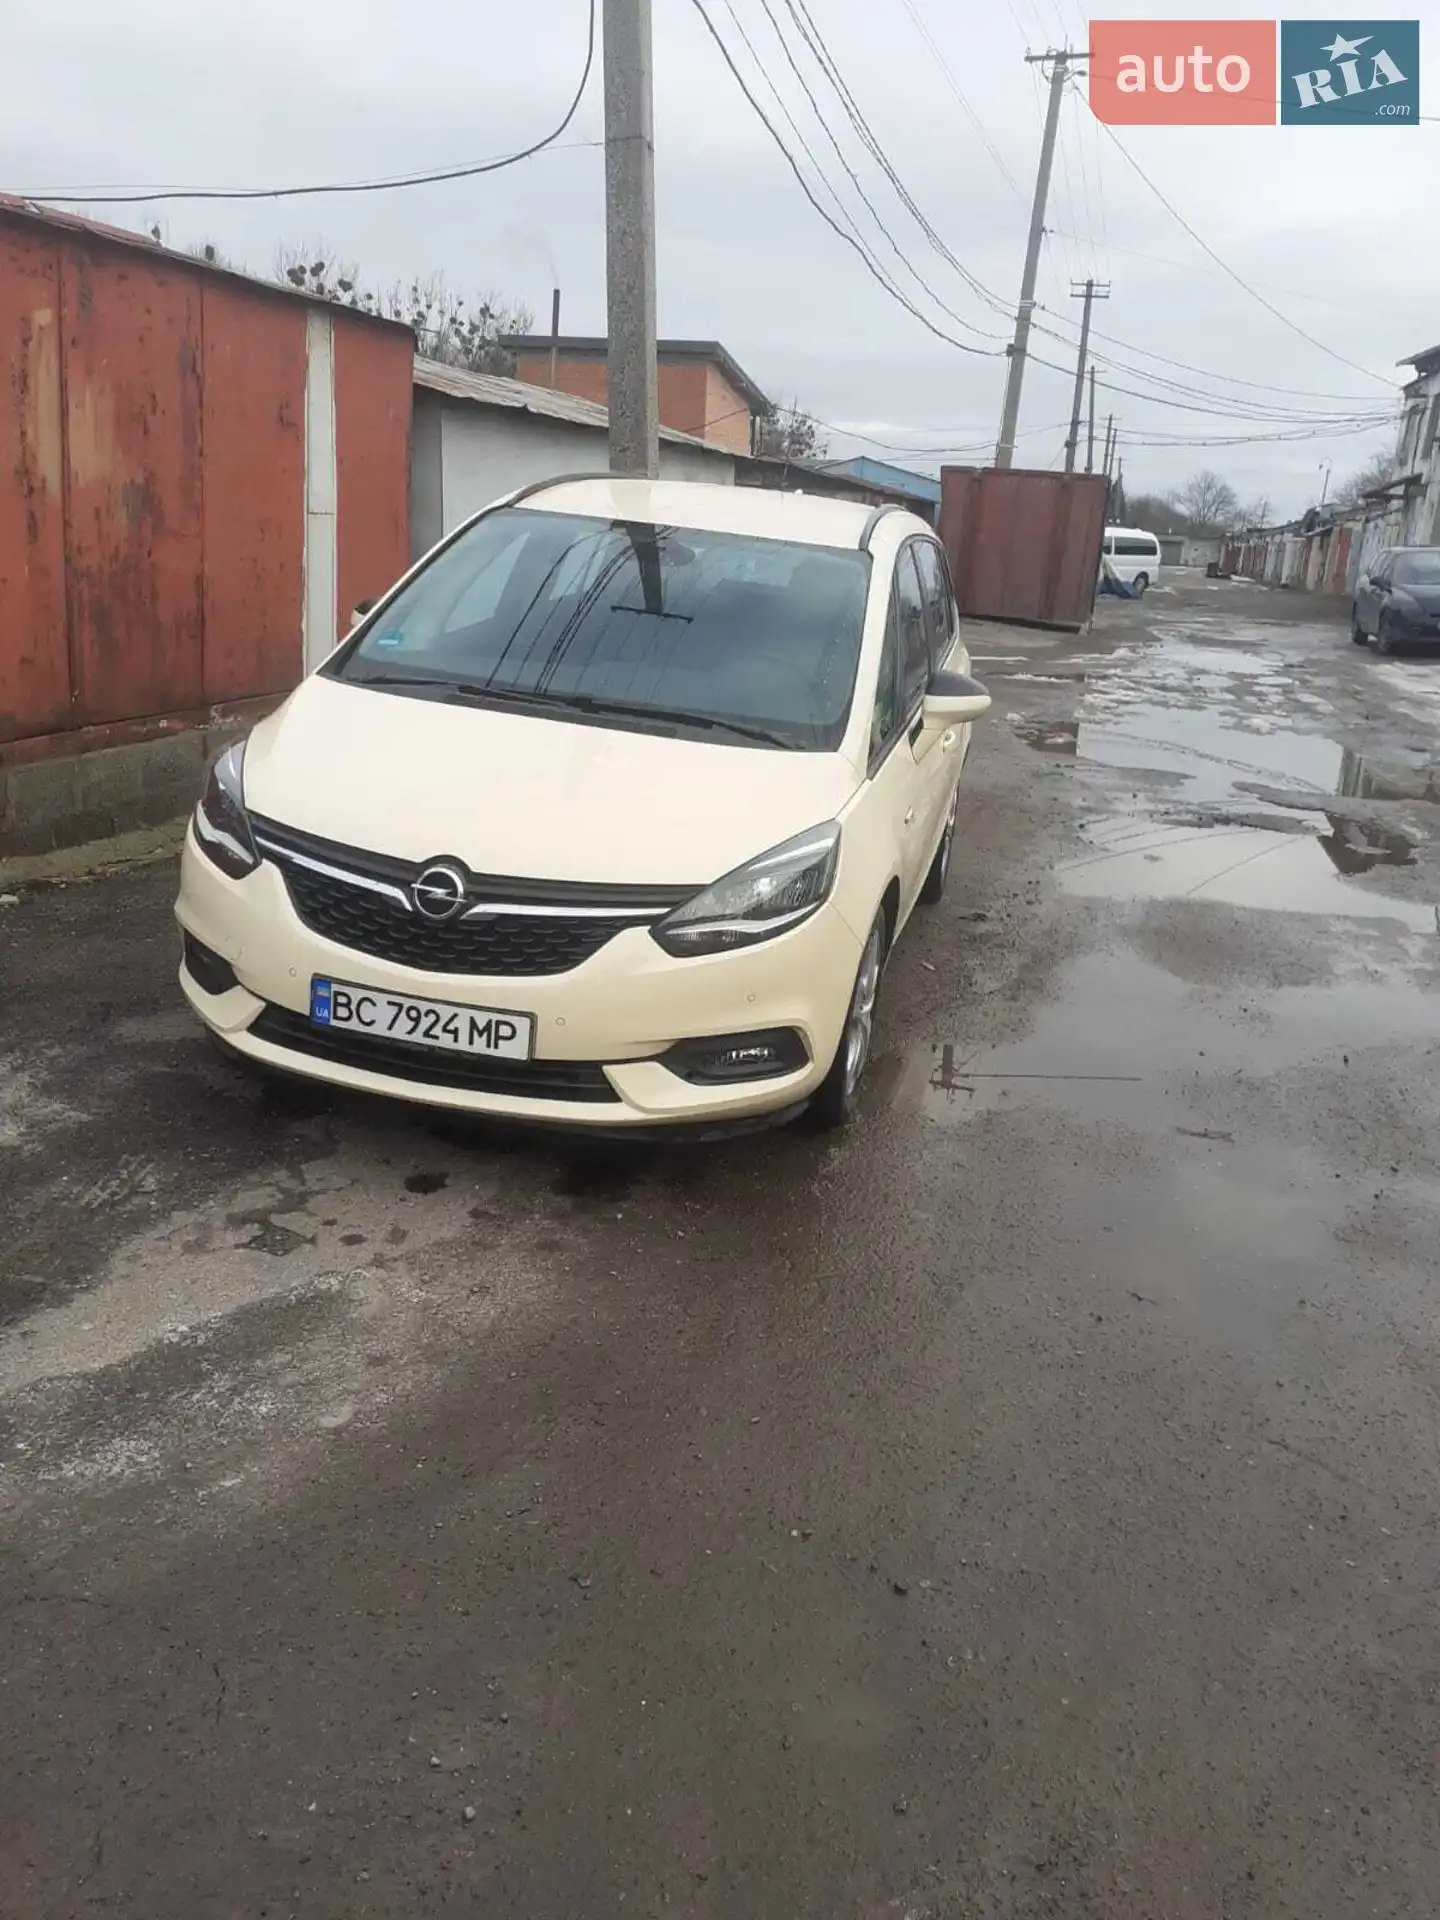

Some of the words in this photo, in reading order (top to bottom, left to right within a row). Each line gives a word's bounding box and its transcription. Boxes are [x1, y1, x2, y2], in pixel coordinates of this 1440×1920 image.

[316, 1006, 329, 1019] UA
[332, 990, 377, 1027] BC
[386, 1000, 460, 1044] 7924
[468, 1015, 517, 1050] MP
